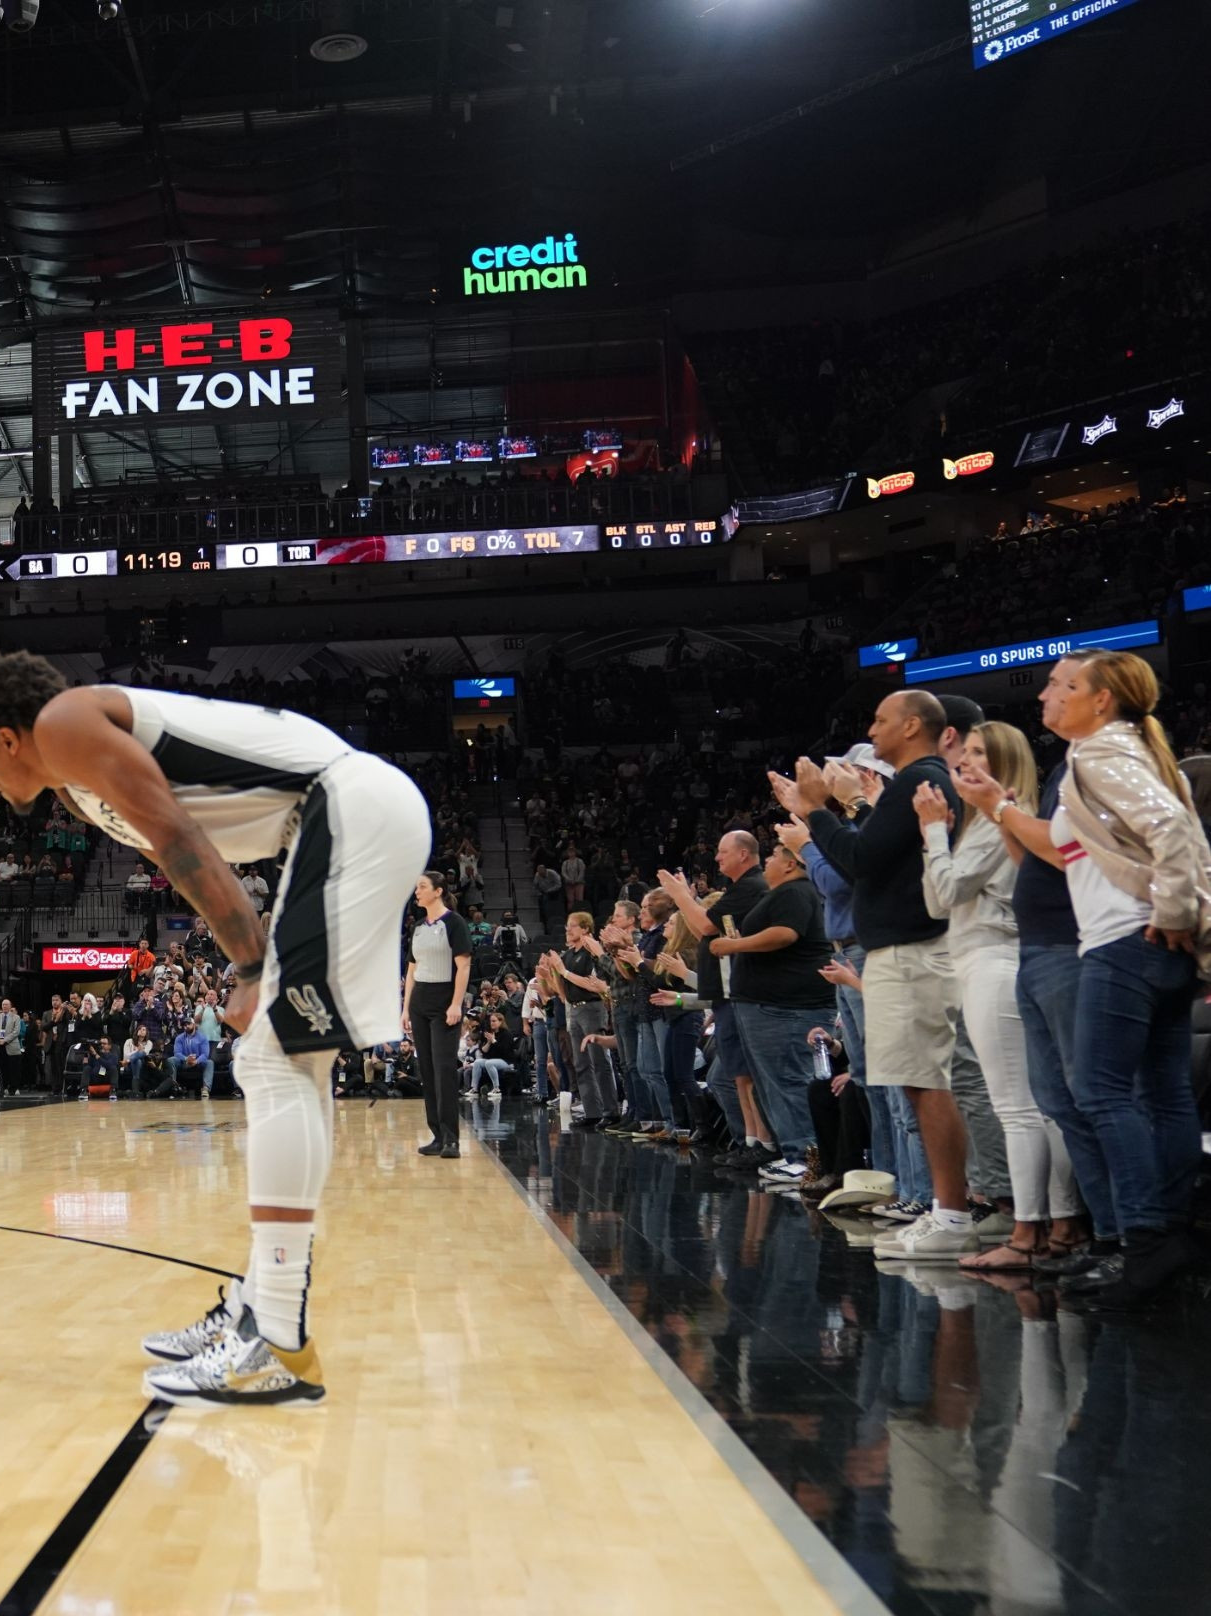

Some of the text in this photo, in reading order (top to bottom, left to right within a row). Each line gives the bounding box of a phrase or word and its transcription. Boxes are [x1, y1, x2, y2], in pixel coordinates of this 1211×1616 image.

[993, 20, 1016, 35] LYLES
[1050, 14, 1069, 30] THE
[1004, 28, 1040, 52] Frost
[471, 233, 578, 270] credit
[464, 264, 587, 295] human
[84, 318, 293, 372] H-E-B
[62, 367, 316, 419] FAN ZONE
[606, 521, 716, 536] BLK STL AST REB
[405, 531, 584, 554] F 0 FG 0% TOL 7
[612, 532, 711, 548] 0 0 0 0
[124, 552, 182, 570] 11:19
[198, 548, 204, 559] 1
[243, 546, 258, 566] 0
[288, 546, 310, 560] TOR
[73, 556, 88, 574] 0
[192, 562, 210, 570] QTR
[980, 640, 1071, 667] GO SPURS GO!
[52, 952, 84, 964] LUCKY
